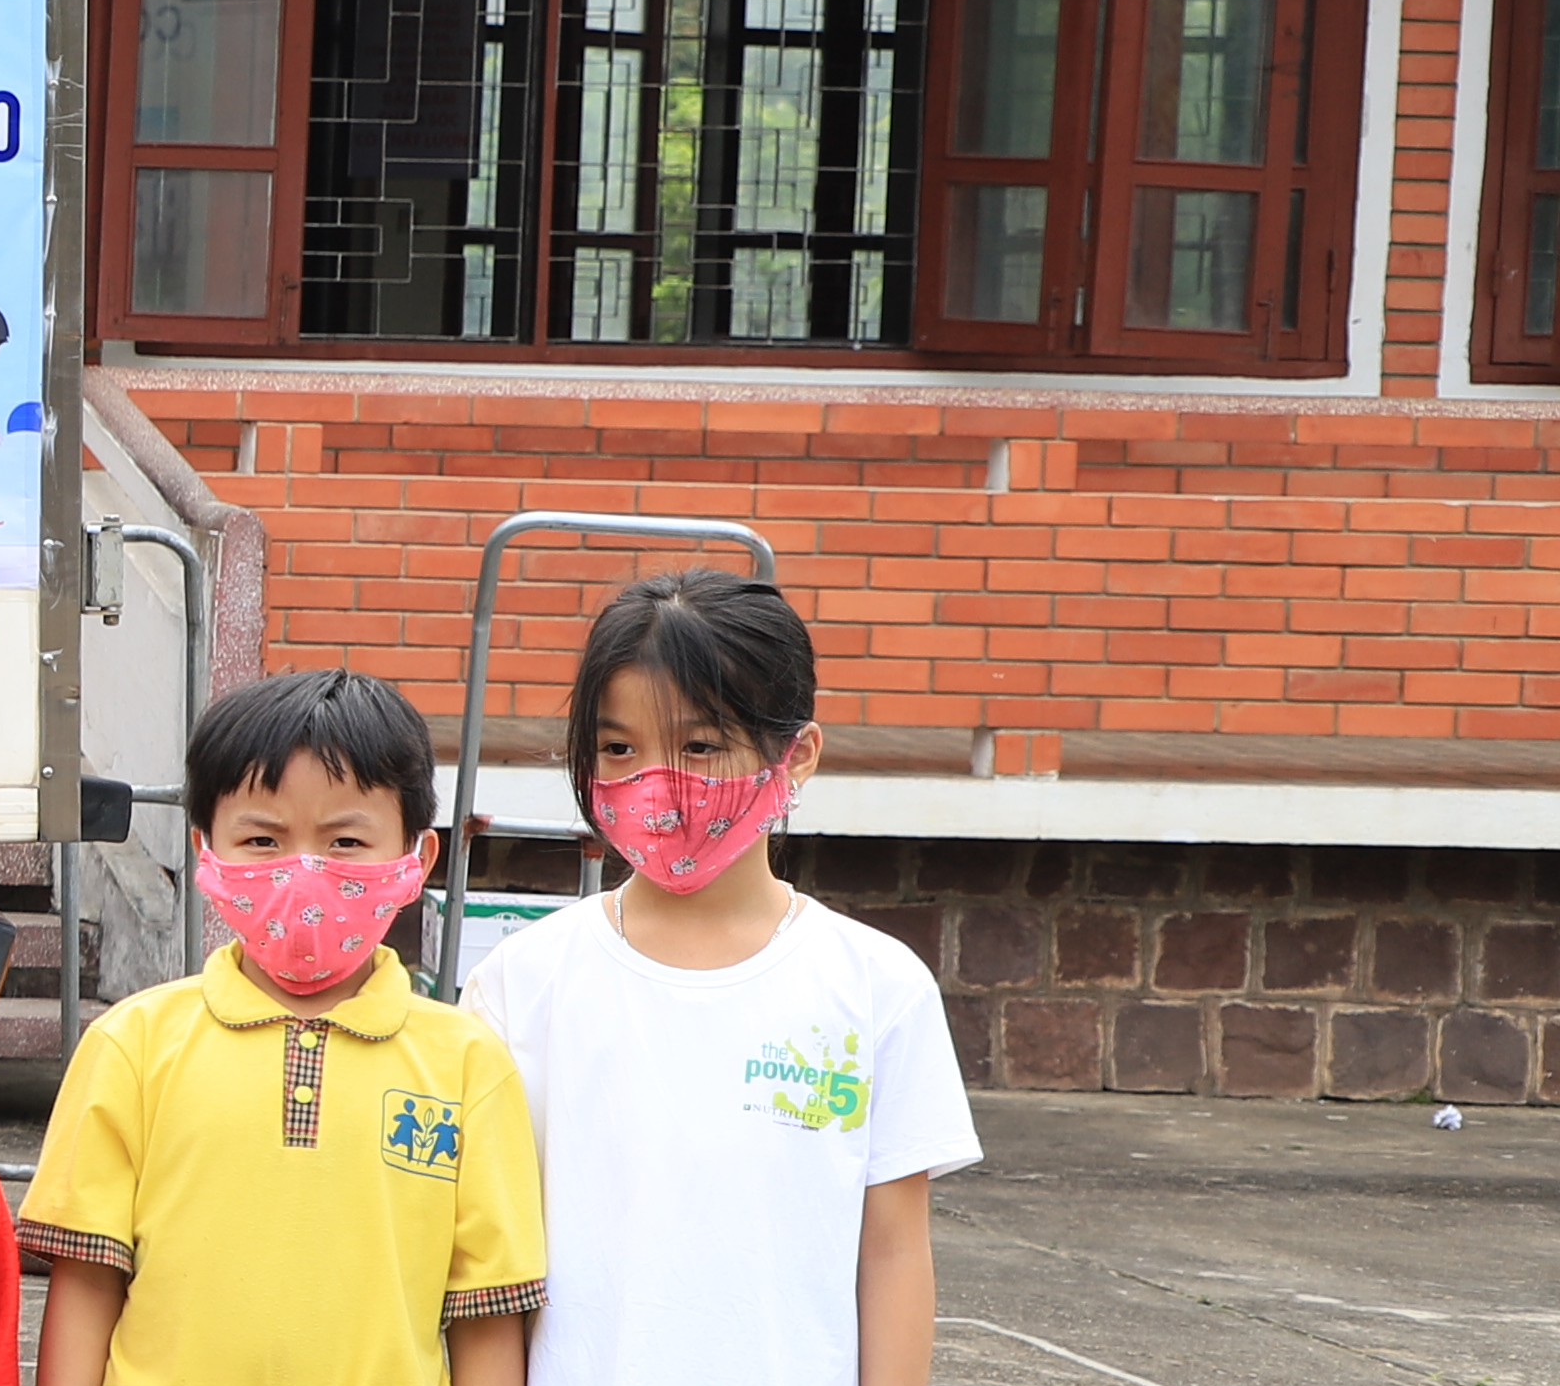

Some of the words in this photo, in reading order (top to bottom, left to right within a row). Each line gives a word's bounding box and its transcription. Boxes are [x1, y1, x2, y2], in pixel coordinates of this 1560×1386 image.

[761, 1041, 788, 1061] the
[745, 1059, 830, 1087] power
[807, 1090, 825, 1108] of
[828, 1072, 860, 1116] 5
[753, 1104, 826, 1124] NUTRILITE
